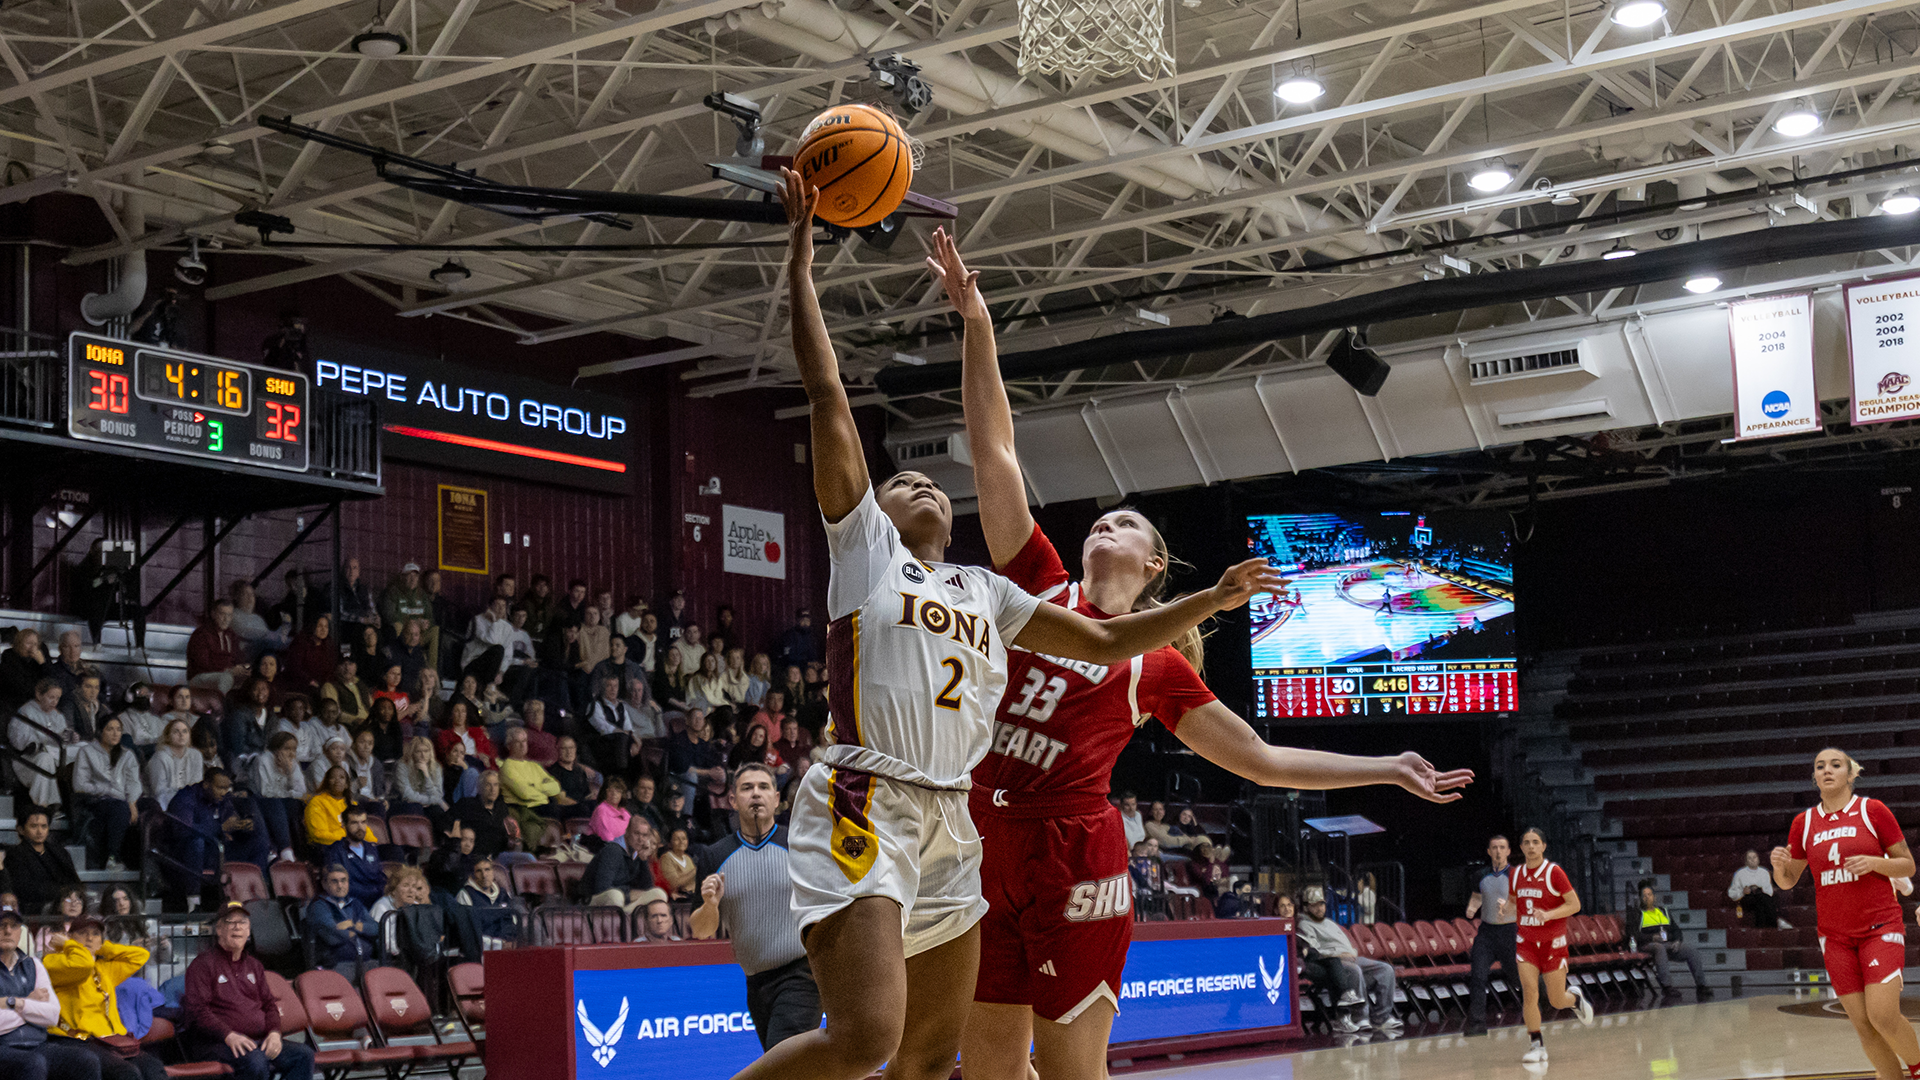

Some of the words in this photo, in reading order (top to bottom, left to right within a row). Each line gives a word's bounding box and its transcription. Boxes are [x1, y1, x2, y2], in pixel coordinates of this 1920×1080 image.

[803, 144, 838, 181] EVO
[1856, 290, 1920, 305] VOLLEYBALL
[1741, 308, 1802, 322] VOLLEYBALL
[1875, 312, 1905, 324] 2002
[1758, 330, 1786, 341] 2004
[1876, 325, 1905, 336] 2004
[1761, 342, 1785, 353] 2018
[1878, 337, 1904, 348] 2018
[86, 344, 124, 366] IONA
[88, 370, 129, 414] 30
[165, 363, 242, 409] 4:16
[265, 377, 296, 396] SHU
[1877, 373, 1911, 397] MAAC
[317, 359, 407, 402] PEPE
[416, 380, 510, 421] AUTO
[519, 398, 627, 440] GROUP
[1858, 396, 1897, 407] REGULAR
[172, 409, 194, 422] POSS
[1764, 402, 1791, 414] NCAA
[100, 419, 137, 437] BONUS
[164, 420, 202, 438] PERIOD
[265, 401, 300, 442] 32
[1745, 417, 1811, 432] APPEARANCES
[208, 420, 223, 452] 3
[249, 442, 282, 460] BONUS
[450, 491, 477, 506] IONA
[1893, 495, 1901, 509] 8
[685, 513, 710, 525] SECTION
[693, 525, 702, 542] 6
[727, 520, 765, 544] Apple
[727, 540, 762, 561] Bank
[905, 565, 923, 580] BLM
[896, 590, 991, 660] IONA
[935, 656, 964, 712] 2
[1331, 678, 1355, 693] 30
[1373, 677, 1408, 691] 4:16
[1417, 676, 1439, 691] 32
[1007, 666, 1068, 723] 33
[1336, 704, 1344, 714] 4
[1352, 704, 1360, 713] 3
[1383, 703, 1391, 712] 3
[1413, 702, 1421, 712] 3
[1429, 702, 1437, 711] 2
[1813, 825, 1857, 846] SACRED
[1828, 842, 1840, 866] 4
[1063, 873, 1132, 922] SHU
[1516, 888, 1543, 898] SACRED
[1526, 899, 1533, 915] 9
[1121, 980, 1146, 999] AIR
[1148, 977, 1193, 996] FORCE
[1196, 973, 1256, 993] RESERVE
[637, 1016, 680, 1040] AIR
[684, 1011, 756, 1036] FORCE
